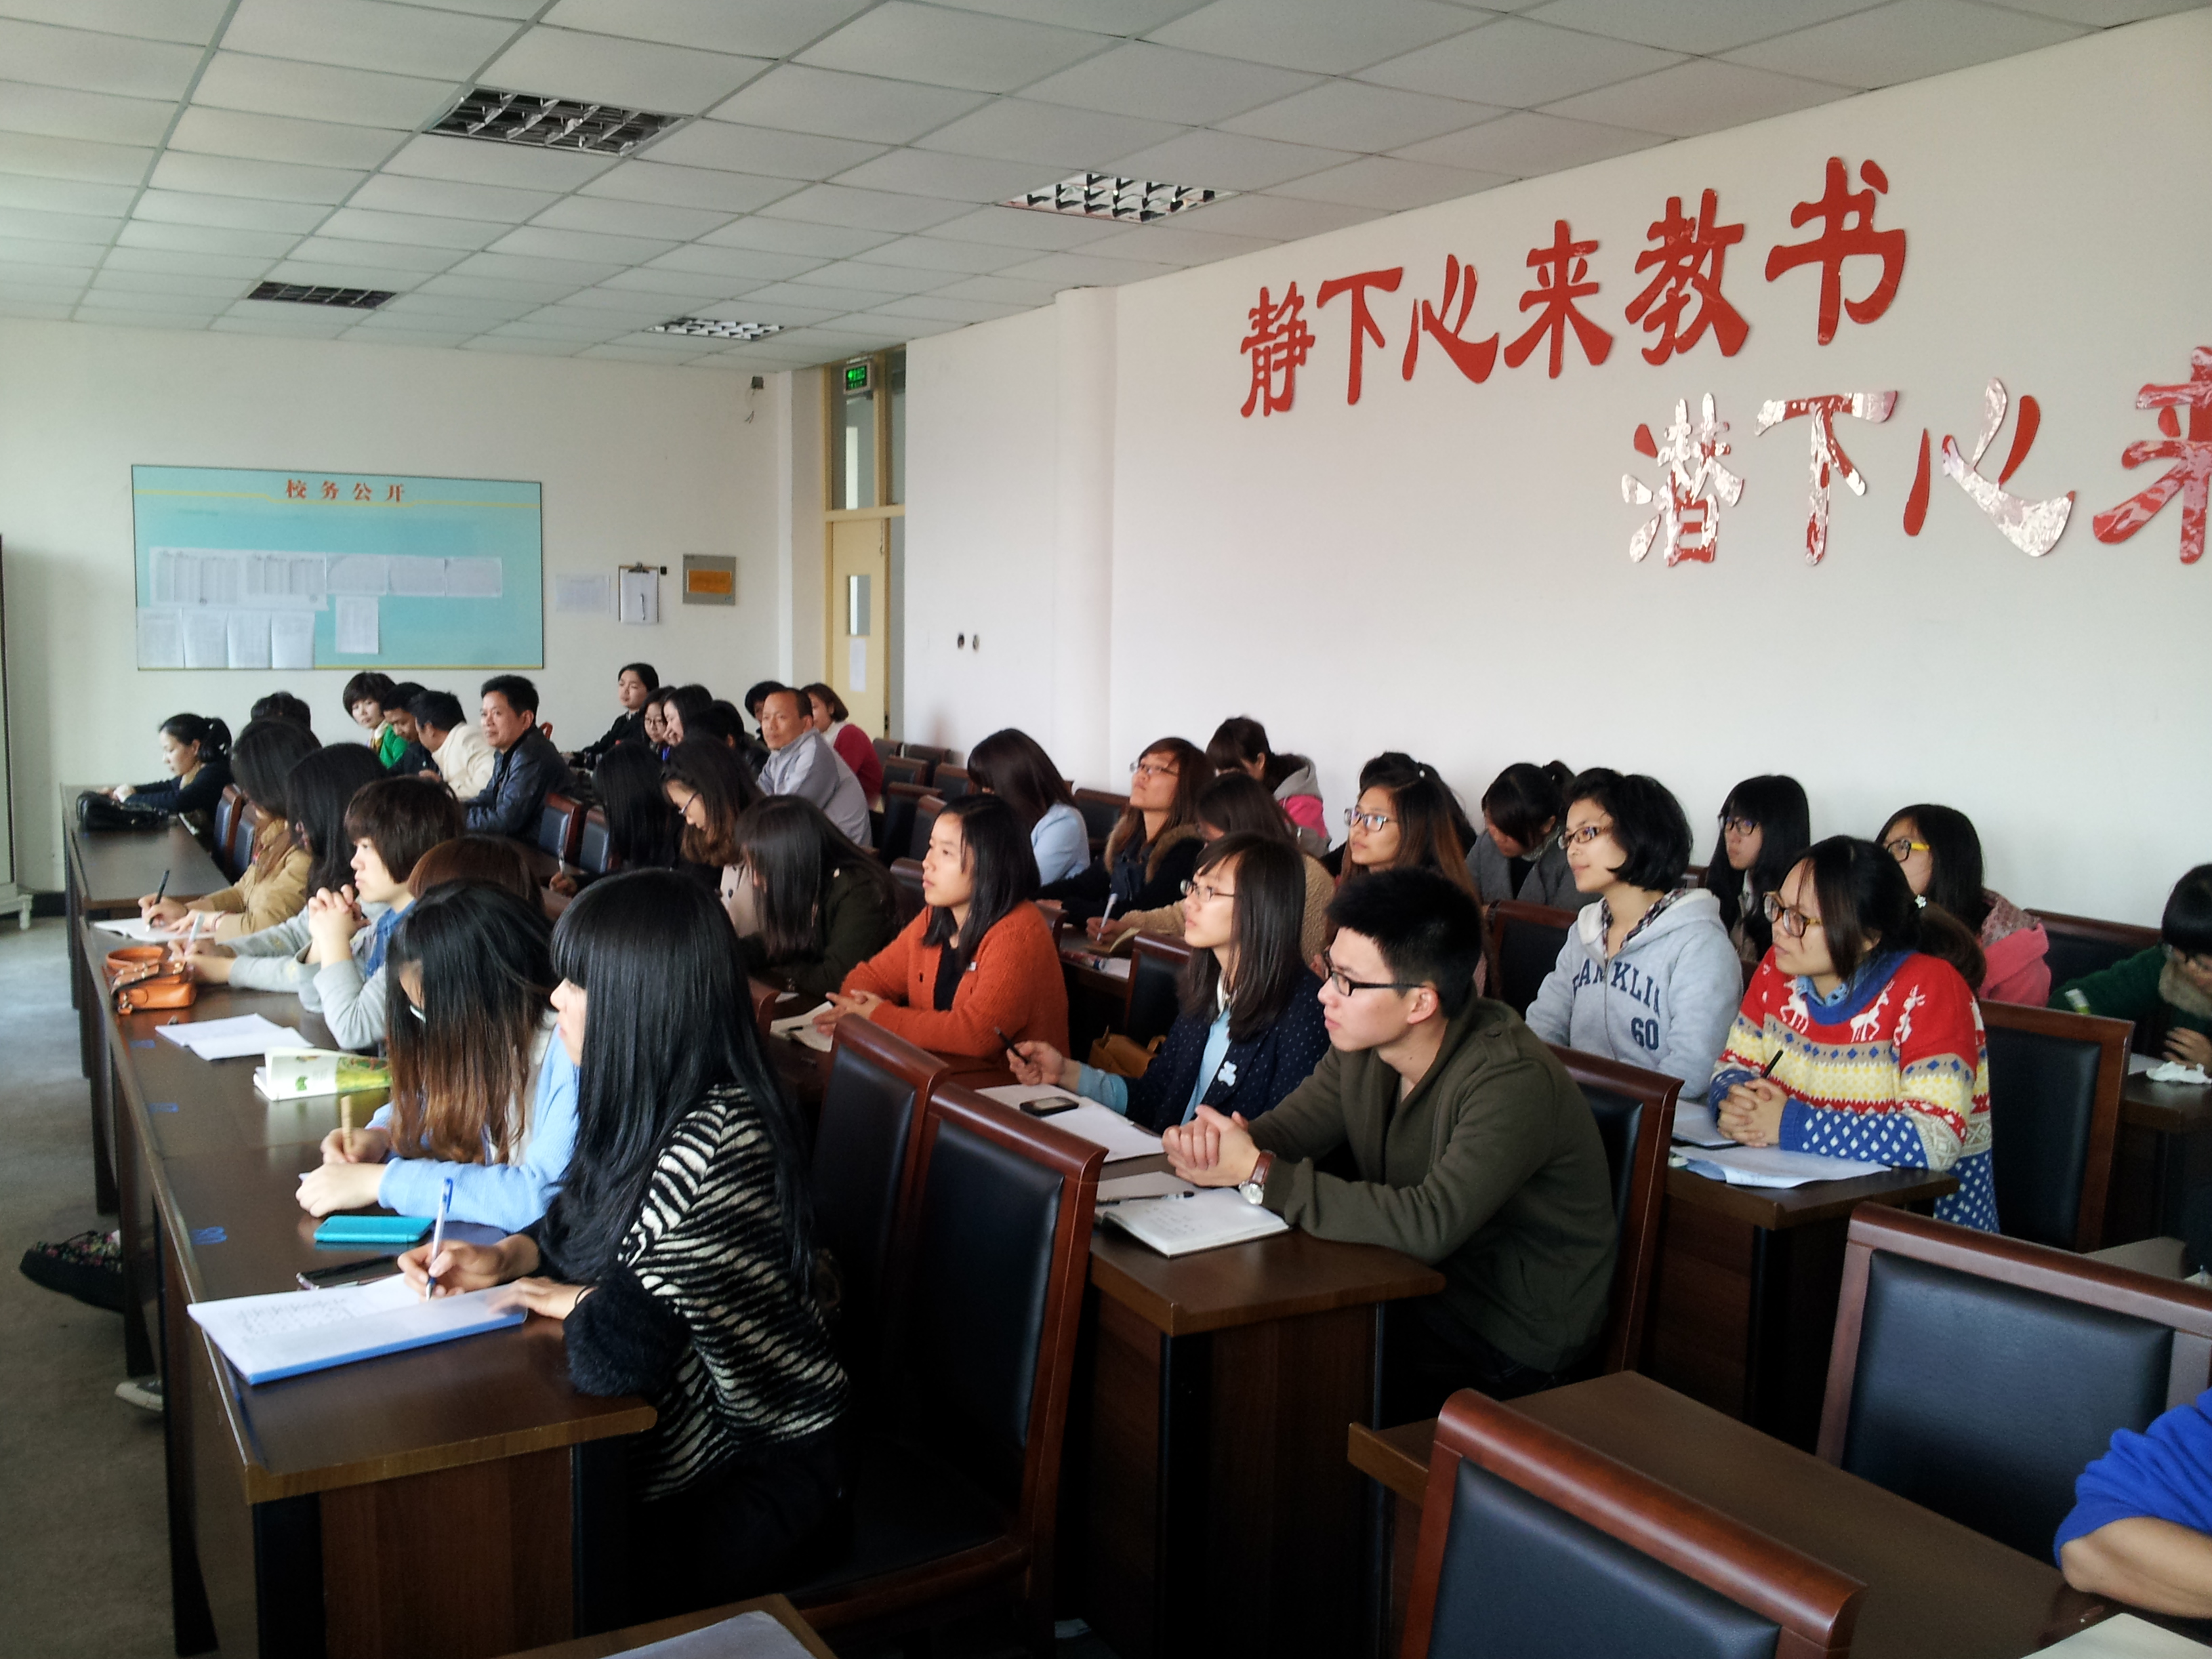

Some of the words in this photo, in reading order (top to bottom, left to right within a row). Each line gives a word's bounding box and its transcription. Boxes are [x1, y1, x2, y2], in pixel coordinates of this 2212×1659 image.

[1240, 156, 1907, 417] 静下心来教书
[286, 478, 405, 503] 校务公开
[1631, 1017, 1659, 1050] 60
